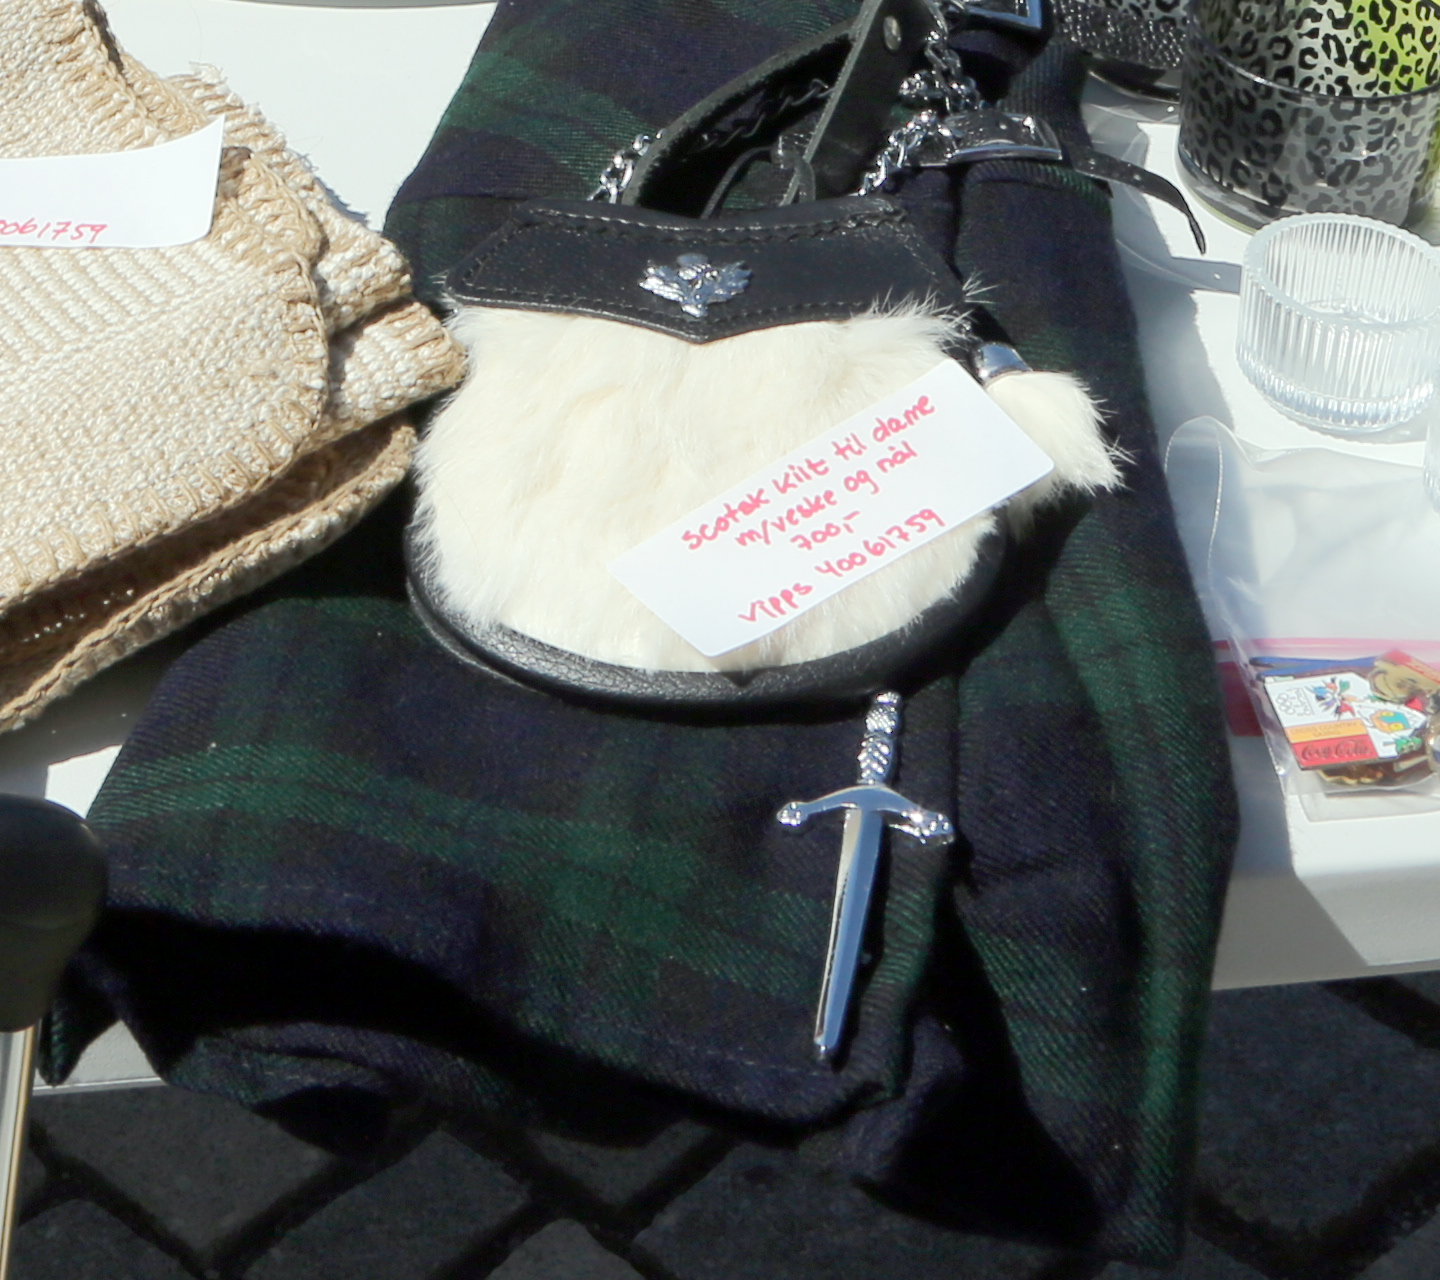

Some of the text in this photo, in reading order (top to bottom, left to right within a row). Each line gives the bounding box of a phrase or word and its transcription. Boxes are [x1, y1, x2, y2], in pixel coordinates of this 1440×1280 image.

[872, 394, 936, 442] dame
[842, 469, 881, 495] og
[813, 508, 946, 578] 40061759
